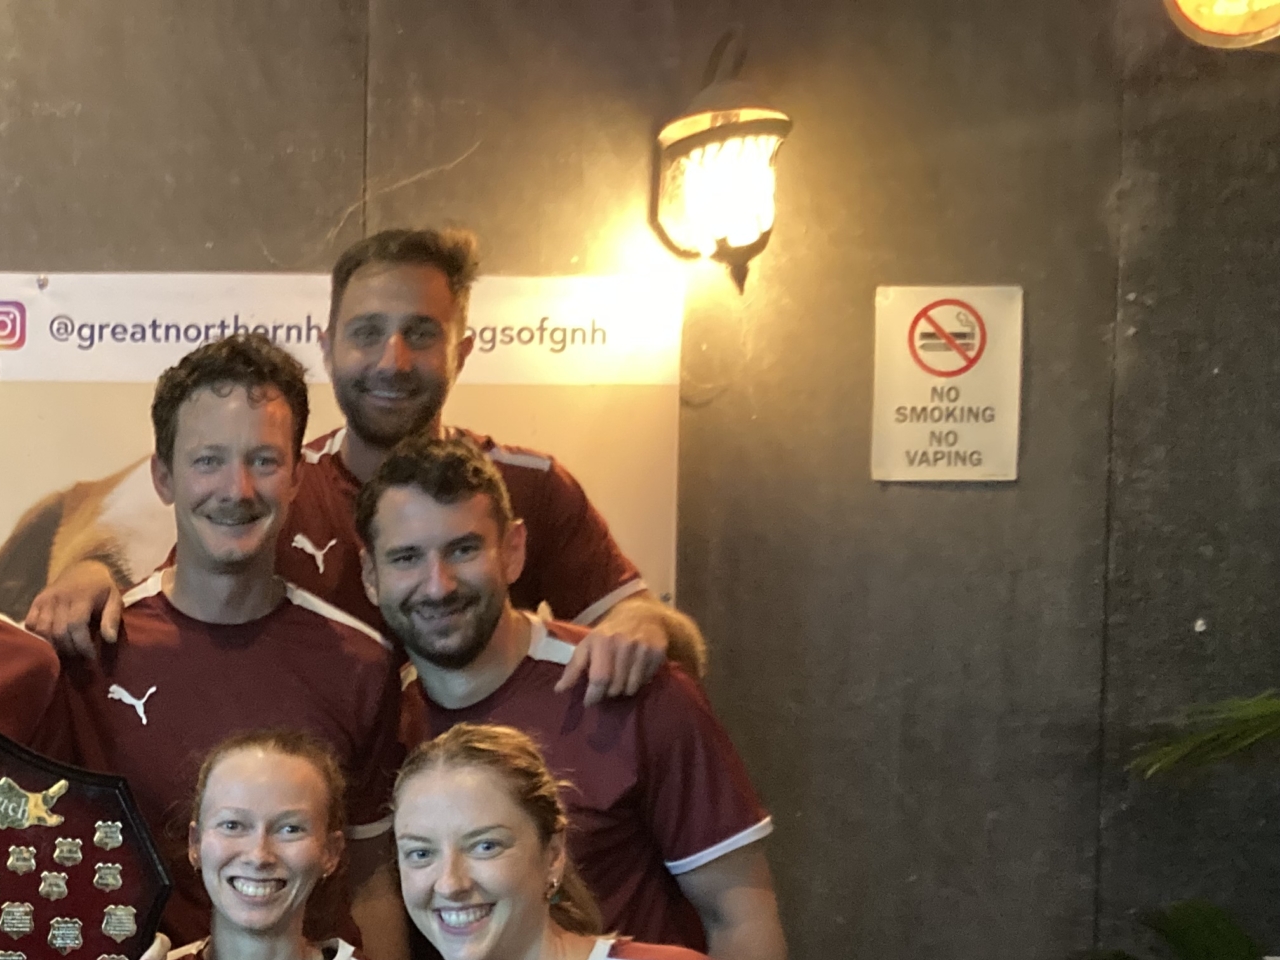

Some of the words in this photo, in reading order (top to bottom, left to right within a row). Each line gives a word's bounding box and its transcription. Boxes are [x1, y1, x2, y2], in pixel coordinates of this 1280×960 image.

[49, 305, 325, 350] @greatnorthernh
[929, 385, 960, 403] NO
[894, 405, 996, 424] SMOKING
[928, 430, 959, 448] NO
[904, 449, 984, 468] VAPING
